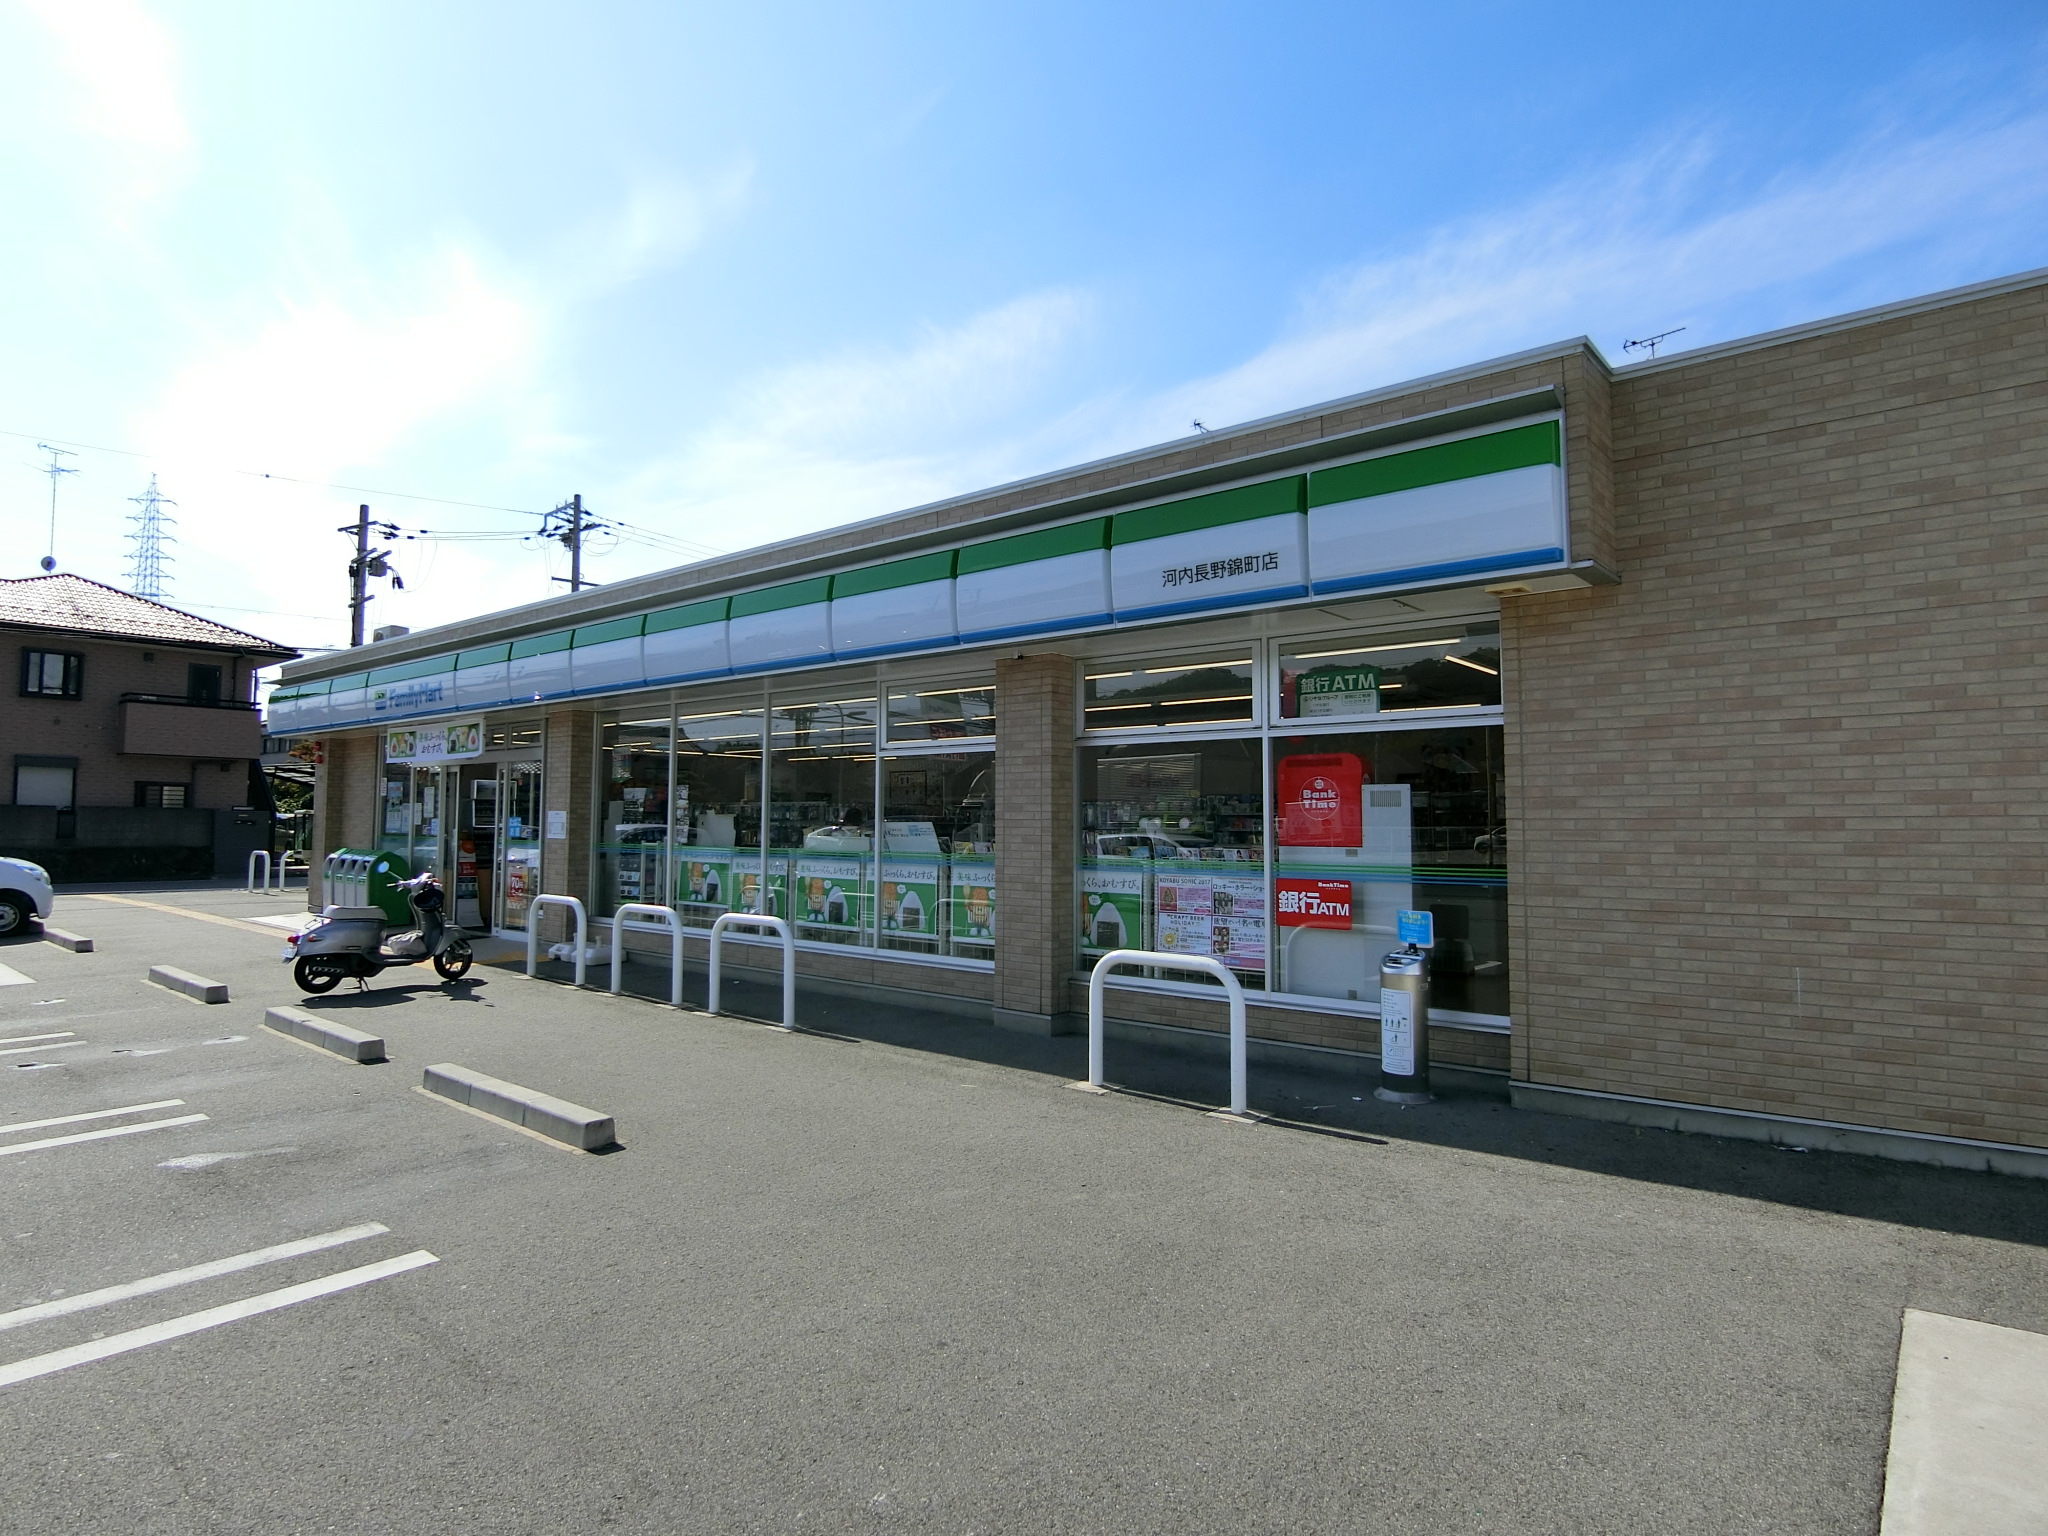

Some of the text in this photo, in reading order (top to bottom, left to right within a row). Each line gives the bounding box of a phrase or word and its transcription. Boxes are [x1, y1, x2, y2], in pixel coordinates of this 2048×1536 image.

[1162, 552, 1278, 587] 河内長野錦町店
[389, 681, 443, 708] FamilyMart
[1301, 673, 1375, 693] 銀行ATM
[1303, 789, 1336, 799] Bank
[1303, 799, 1337, 809] Time
[1278, 890, 1349, 916] 銀行ATM
